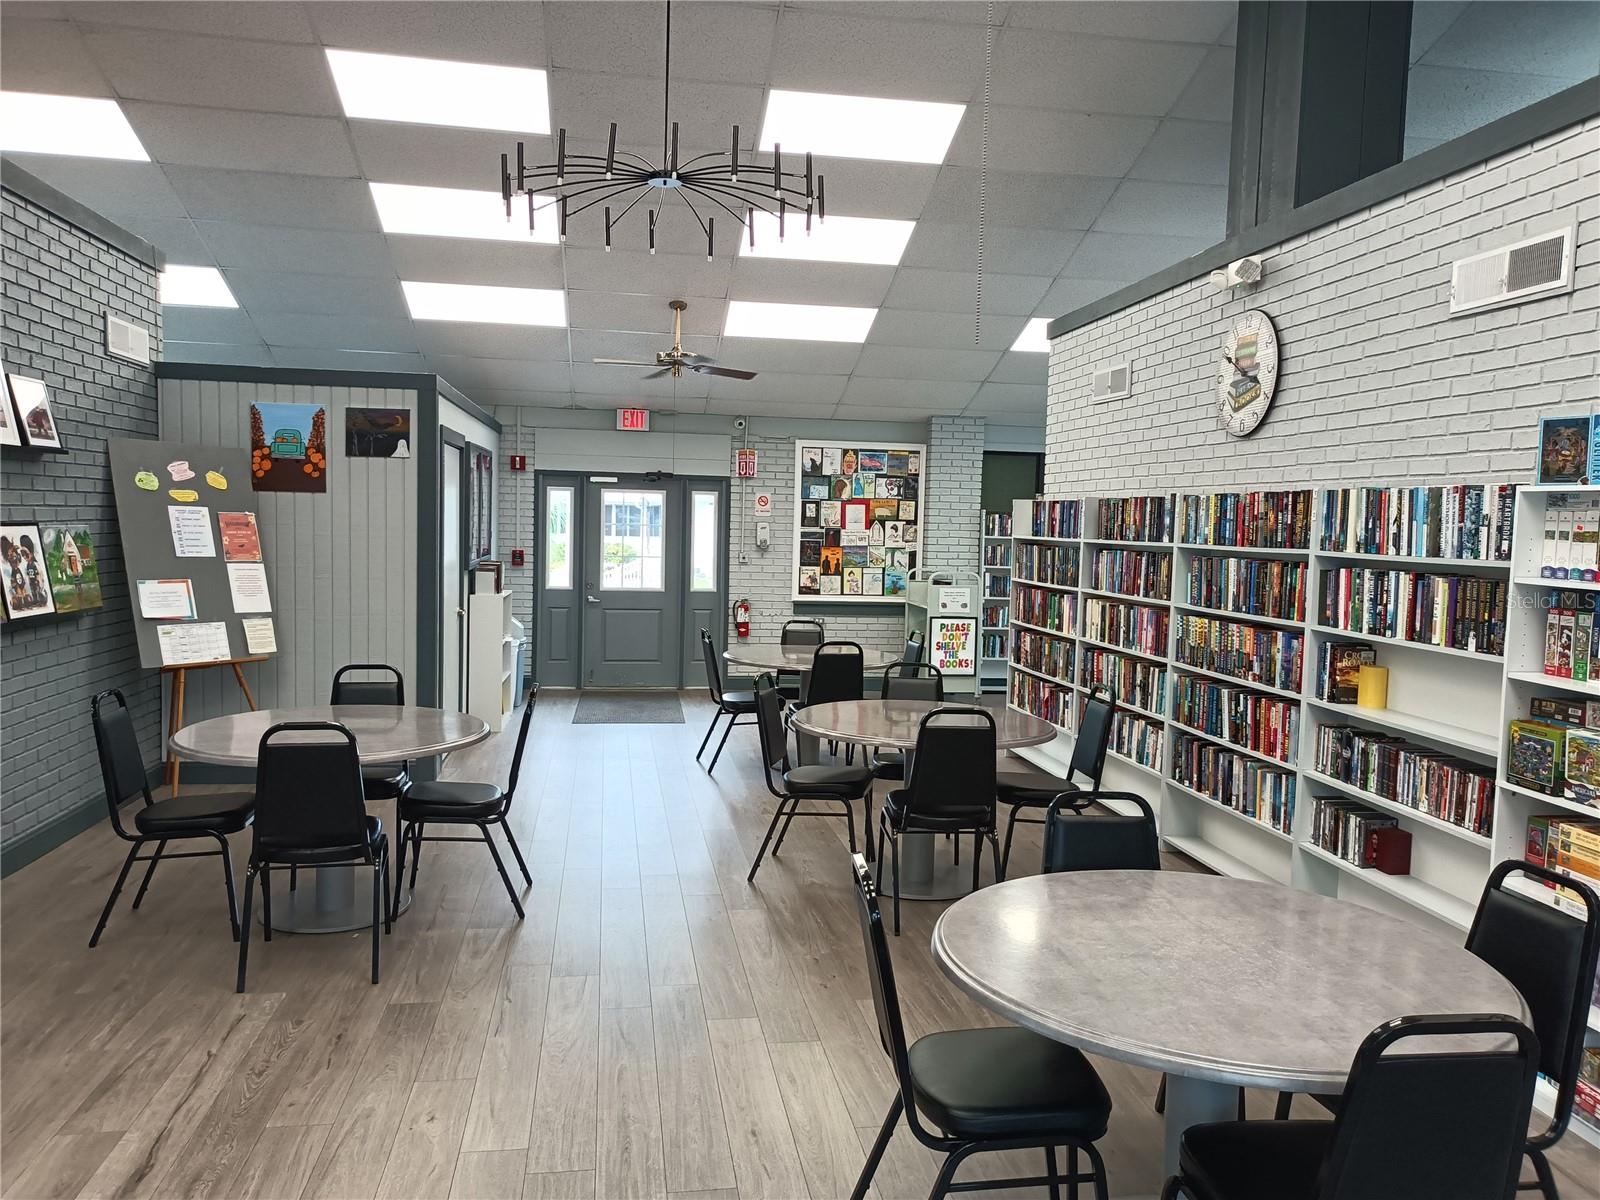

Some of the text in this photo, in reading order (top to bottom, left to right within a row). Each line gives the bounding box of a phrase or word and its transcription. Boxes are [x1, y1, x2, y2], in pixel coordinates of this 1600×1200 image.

[622, 410, 645, 428] EXIT
[1502, 498, 1512, 540] HEARTBROK
[940, 622, 972, 633] PLEASE
[942, 632, 970, 641] DON'T
[935, 641, 967, 651] SHELVE
[943, 651, 960, 659] THE
[1344, 650, 1360, 660] CRO
[939, 659, 973, 669] BOOKS!
